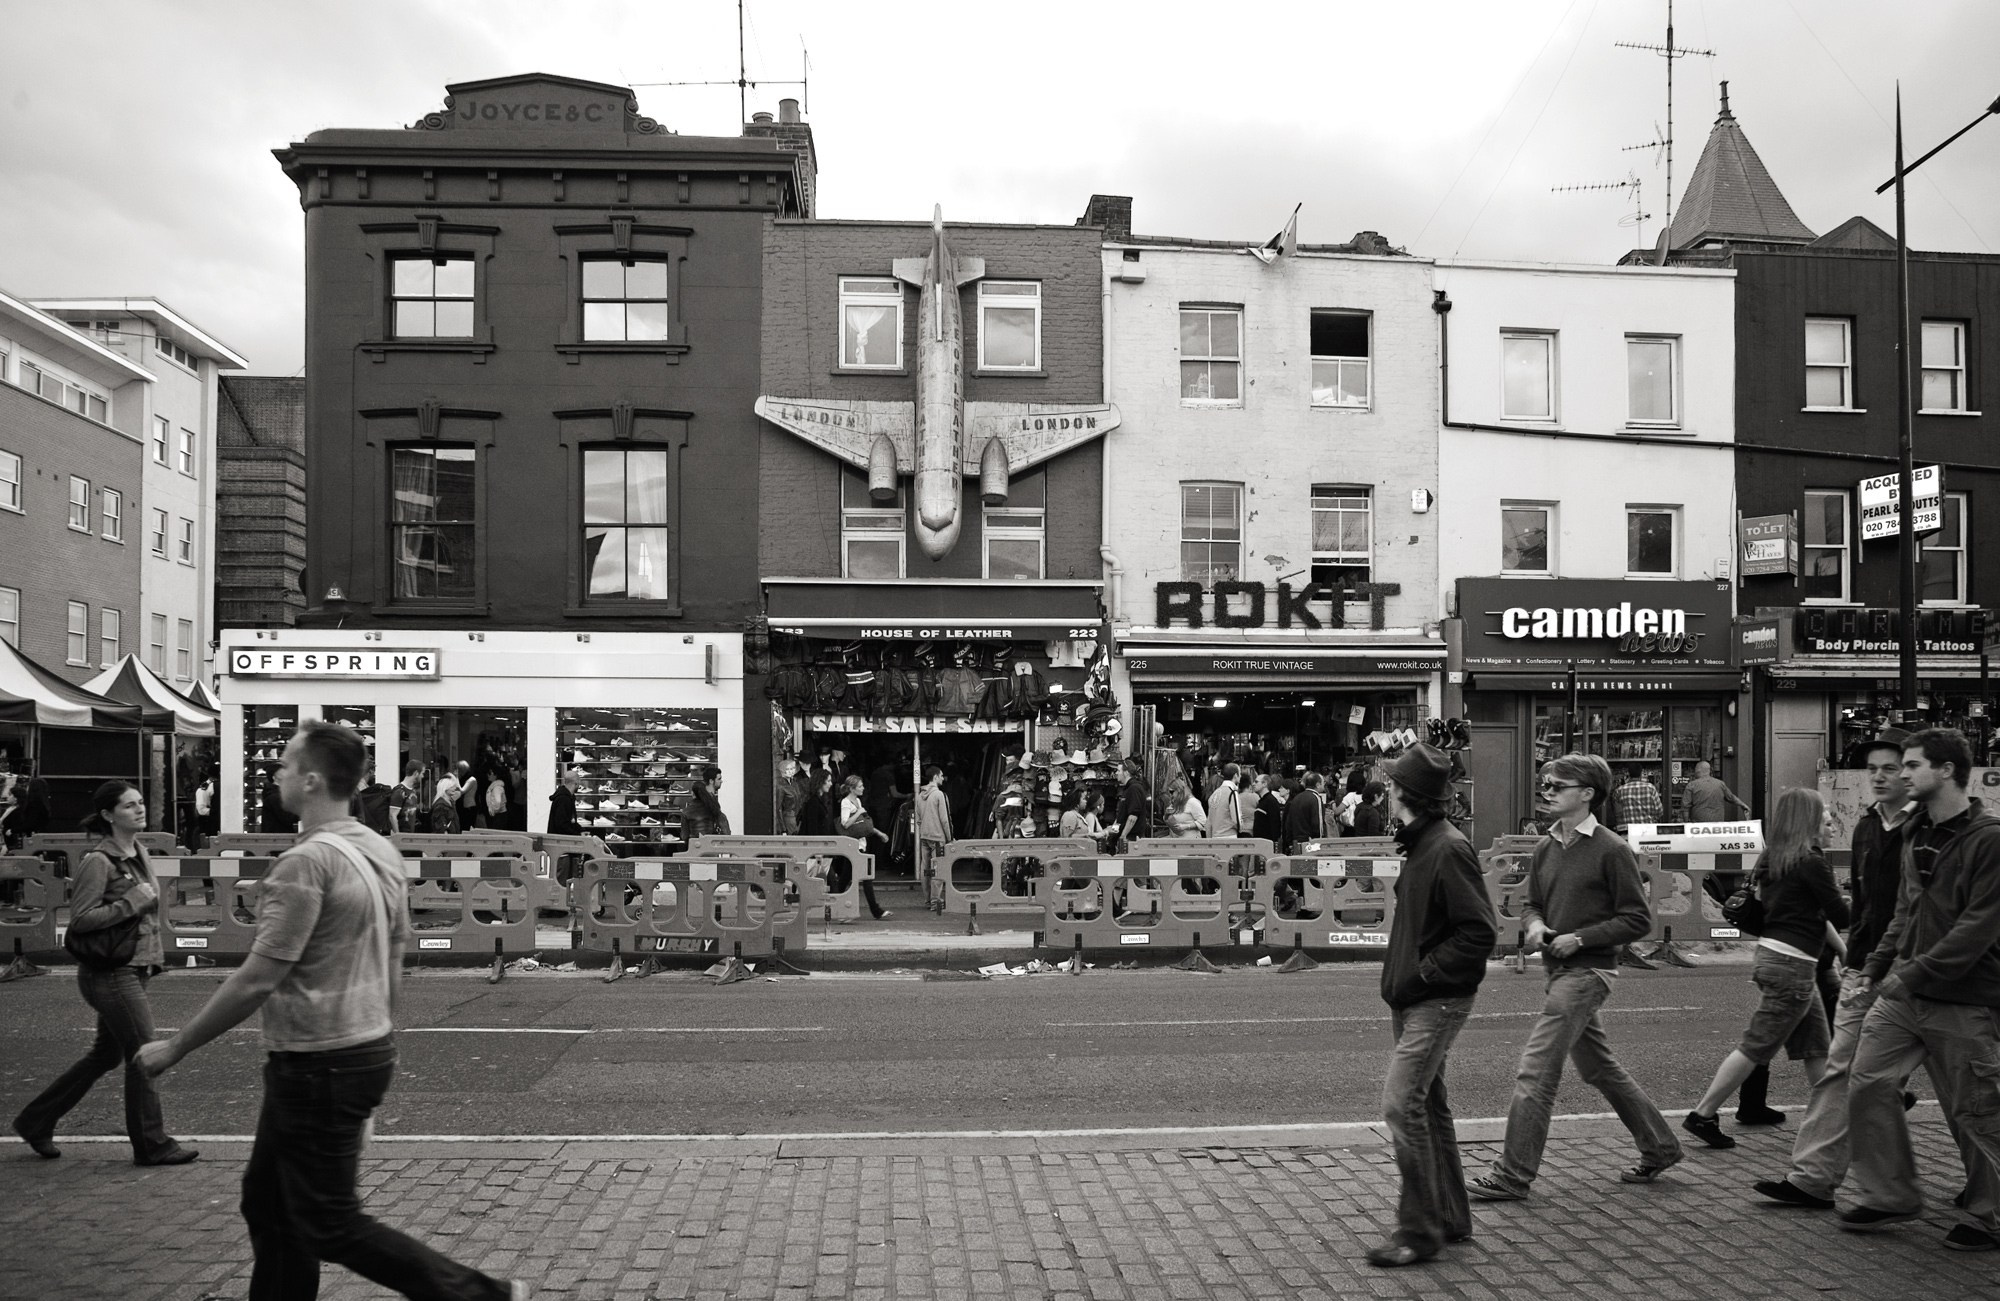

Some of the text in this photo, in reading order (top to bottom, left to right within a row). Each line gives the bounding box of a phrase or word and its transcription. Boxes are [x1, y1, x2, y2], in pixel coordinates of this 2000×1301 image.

[953, 348, 960, 376] OF
[781, 407, 856, 428] LONDON
[1021, 417, 1096, 431] LONDON
[917, 382, 926, 490] LEATHER
[952, 383, 960, 490] LEATHER
[1865, 468, 1933, 491] ACQUED
[1863, 505, 1892, 519] PEARL
[1746, 525, 1784, 535] TO LET
[1866, 522, 1883, 532] 020
[1156, 581, 1401, 631] ROKIT
[1502, 602, 1686, 639] camden
[1810, 613, 1985, 635] CHRME
[861, 629, 1012, 638] HOUSE OF LEATHER
[1069, 629, 1098, 638] 223
[1742, 626, 1777, 644] camden
[1619, 631, 1700, 653] news
[1816, 639, 1850, 652] Body
[1853, 639, 1900, 651] Piercin
[1923, 640, 1975, 651] Tattoos
[237, 654, 430, 671] OFFSPRING
[1130, 660, 1442, 670] 225 ROKIT TRUE VINTAGE www.rokit.co.uk
[1609, 658, 1636, 666] Stationery
[1650, 658, 1673, 666] Greeting
[1603, 681, 1633, 690] NEWS
[1776, 680, 1797, 689] 229
[812, 715, 1018, 733] SALE SALE SALE
[1690, 826, 1755, 835] GABRIEL
